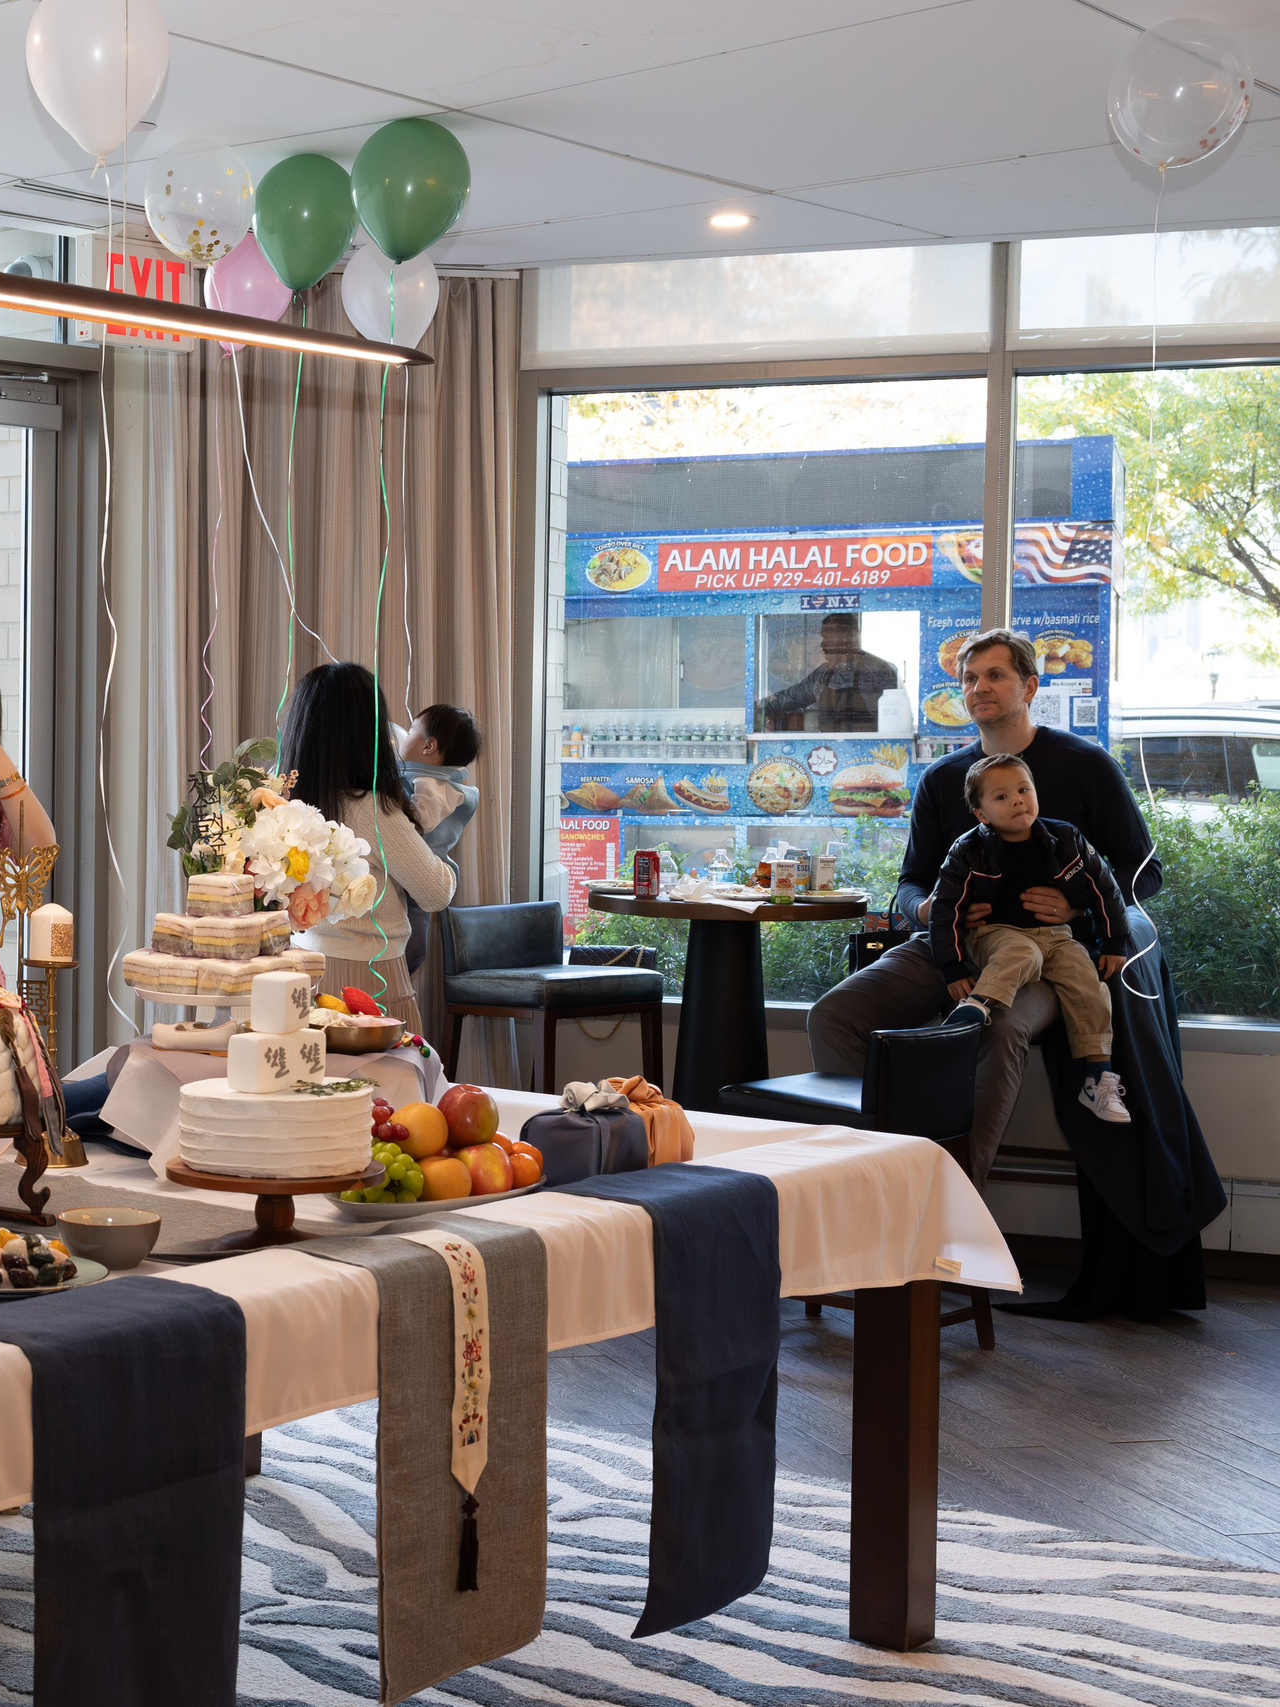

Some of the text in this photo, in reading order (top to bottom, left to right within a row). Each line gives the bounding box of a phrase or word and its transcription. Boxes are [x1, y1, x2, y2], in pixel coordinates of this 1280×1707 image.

[106, 252, 185, 342] EXIT
[594, 541, 615, 552] COMBO
[632, 542, 646, 551] RICE
[663, 542, 928, 573] ALAM HALAL FOOD
[695, 570, 890, 589] PICK UP 929-401-6189
[801, 595, 859, 609] I N.Y.
[927, 615, 953, 628] Fresh
[1011, 616, 1031, 626] arve
[1082, 612, 1099, 624] rice
[944, 633, 958, 645] BEEF
[932, 682, 945, 690] FISH
[842, 756, 896, 767] CHEESEBURGER
[625, 777, 654, 785] SAMOSA
[582, 820, 610, 830] FOOD
[560, 833, 605, 841] SANDWICHES
